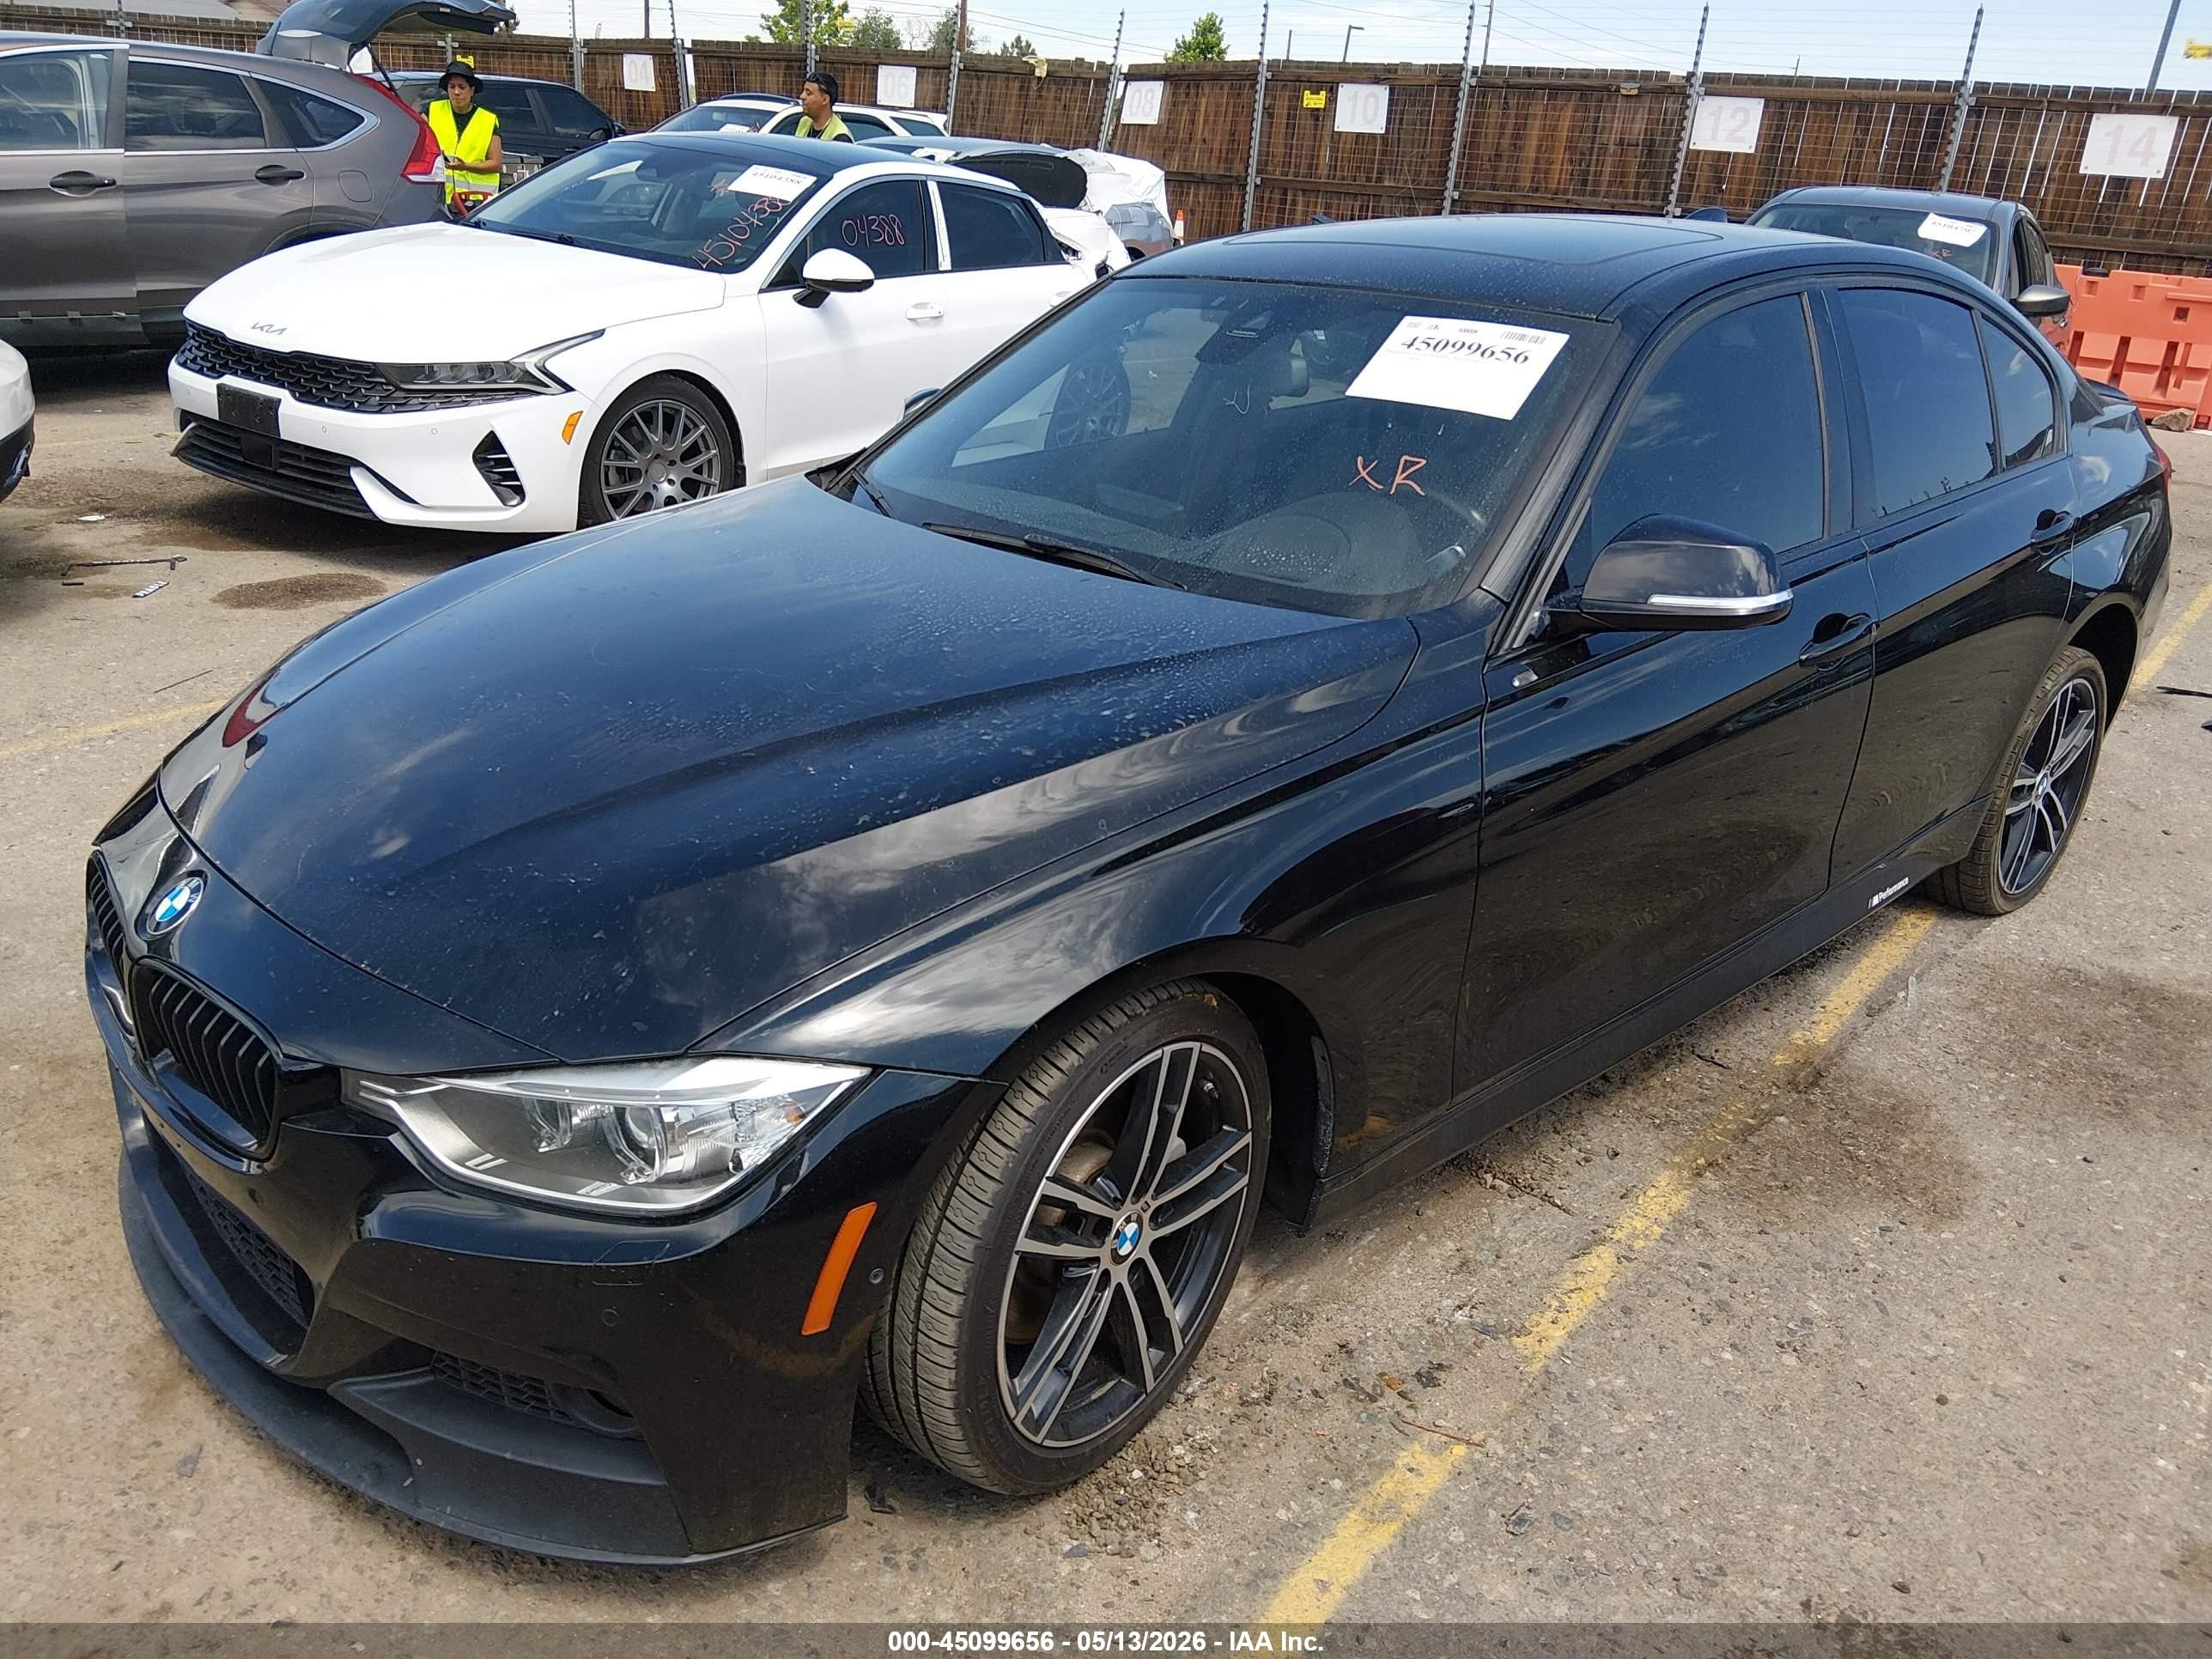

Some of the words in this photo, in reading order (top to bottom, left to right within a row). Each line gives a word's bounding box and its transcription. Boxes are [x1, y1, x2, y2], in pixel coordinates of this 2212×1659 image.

[629, 60, 651, 84] 04
[884, 71, 908, 100] 06
[1129, 88, 1156, 118] 08
[1346, 91, 1379, 125] 10
[1708, 105, 1752, 143] 12
[2105, 123, 2159, 167] 14
[842, 214, 904, 248] 04388
[1401, 336, 1533, 365] 45099656
